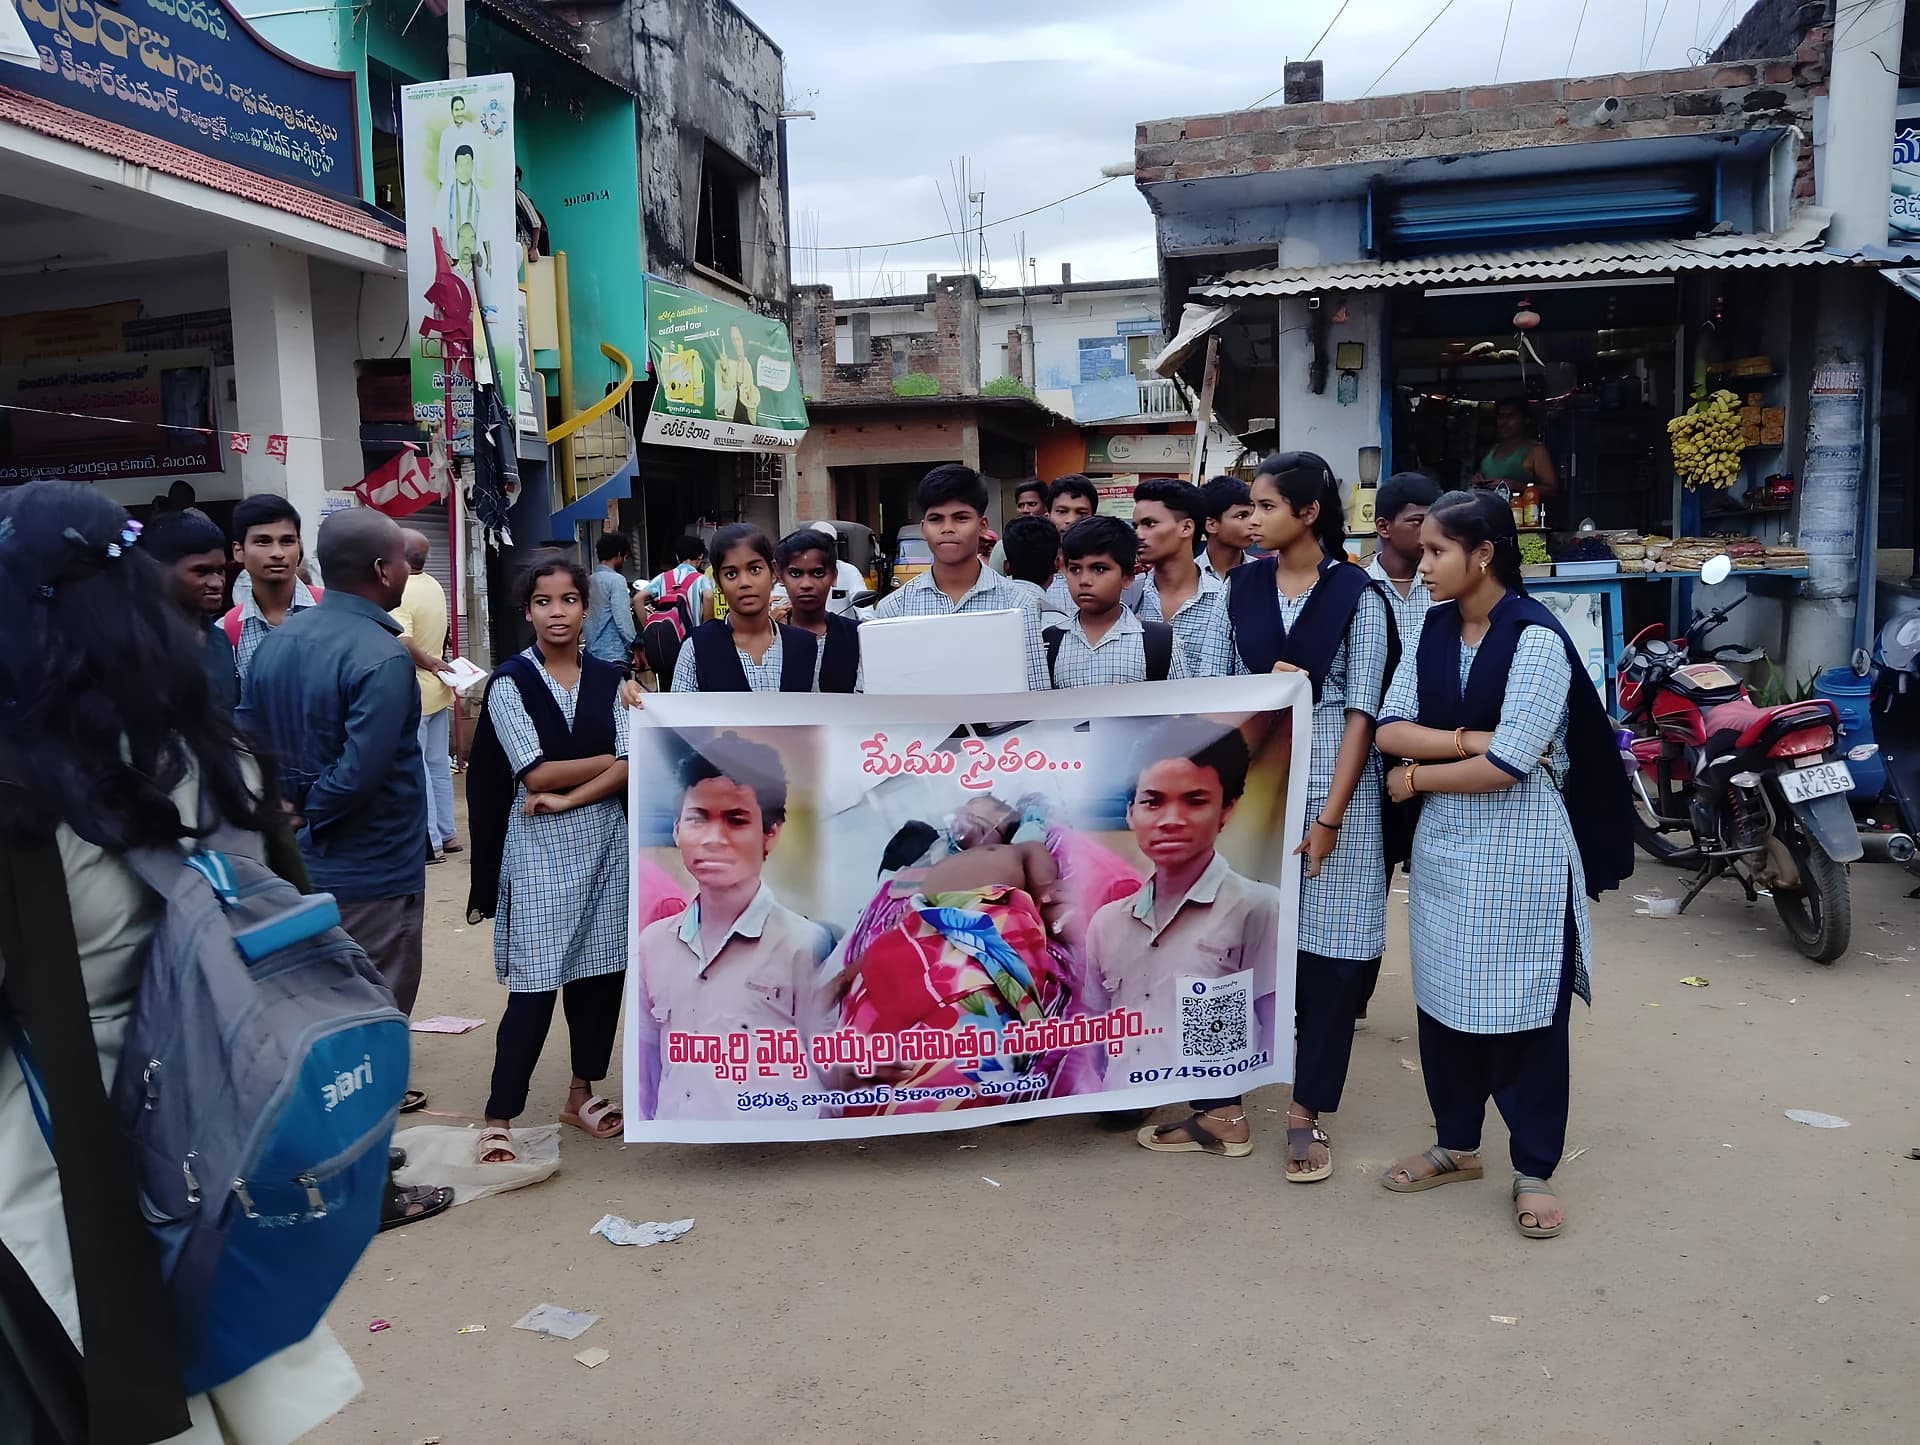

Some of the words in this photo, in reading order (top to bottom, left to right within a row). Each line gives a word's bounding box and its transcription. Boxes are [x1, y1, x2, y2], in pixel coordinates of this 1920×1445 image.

[859, 732, 955, 776] మేము
[959, 736, 1083, 790] సైతం...
[755, 1029, 809, 1079] వైద్య
[812, 1028, 896, 1076] ఖర్చుల
[899, 1023, 997, 1071] నిమిత్తం
[1128, 1050, 1270, 1084] 8074560021
[736, 1091, 799, 1112] ప్రభుత్వ
[801, 1086, 890, 1107] జూనియర్
[980, 1074, 1048, 1096] మందస
